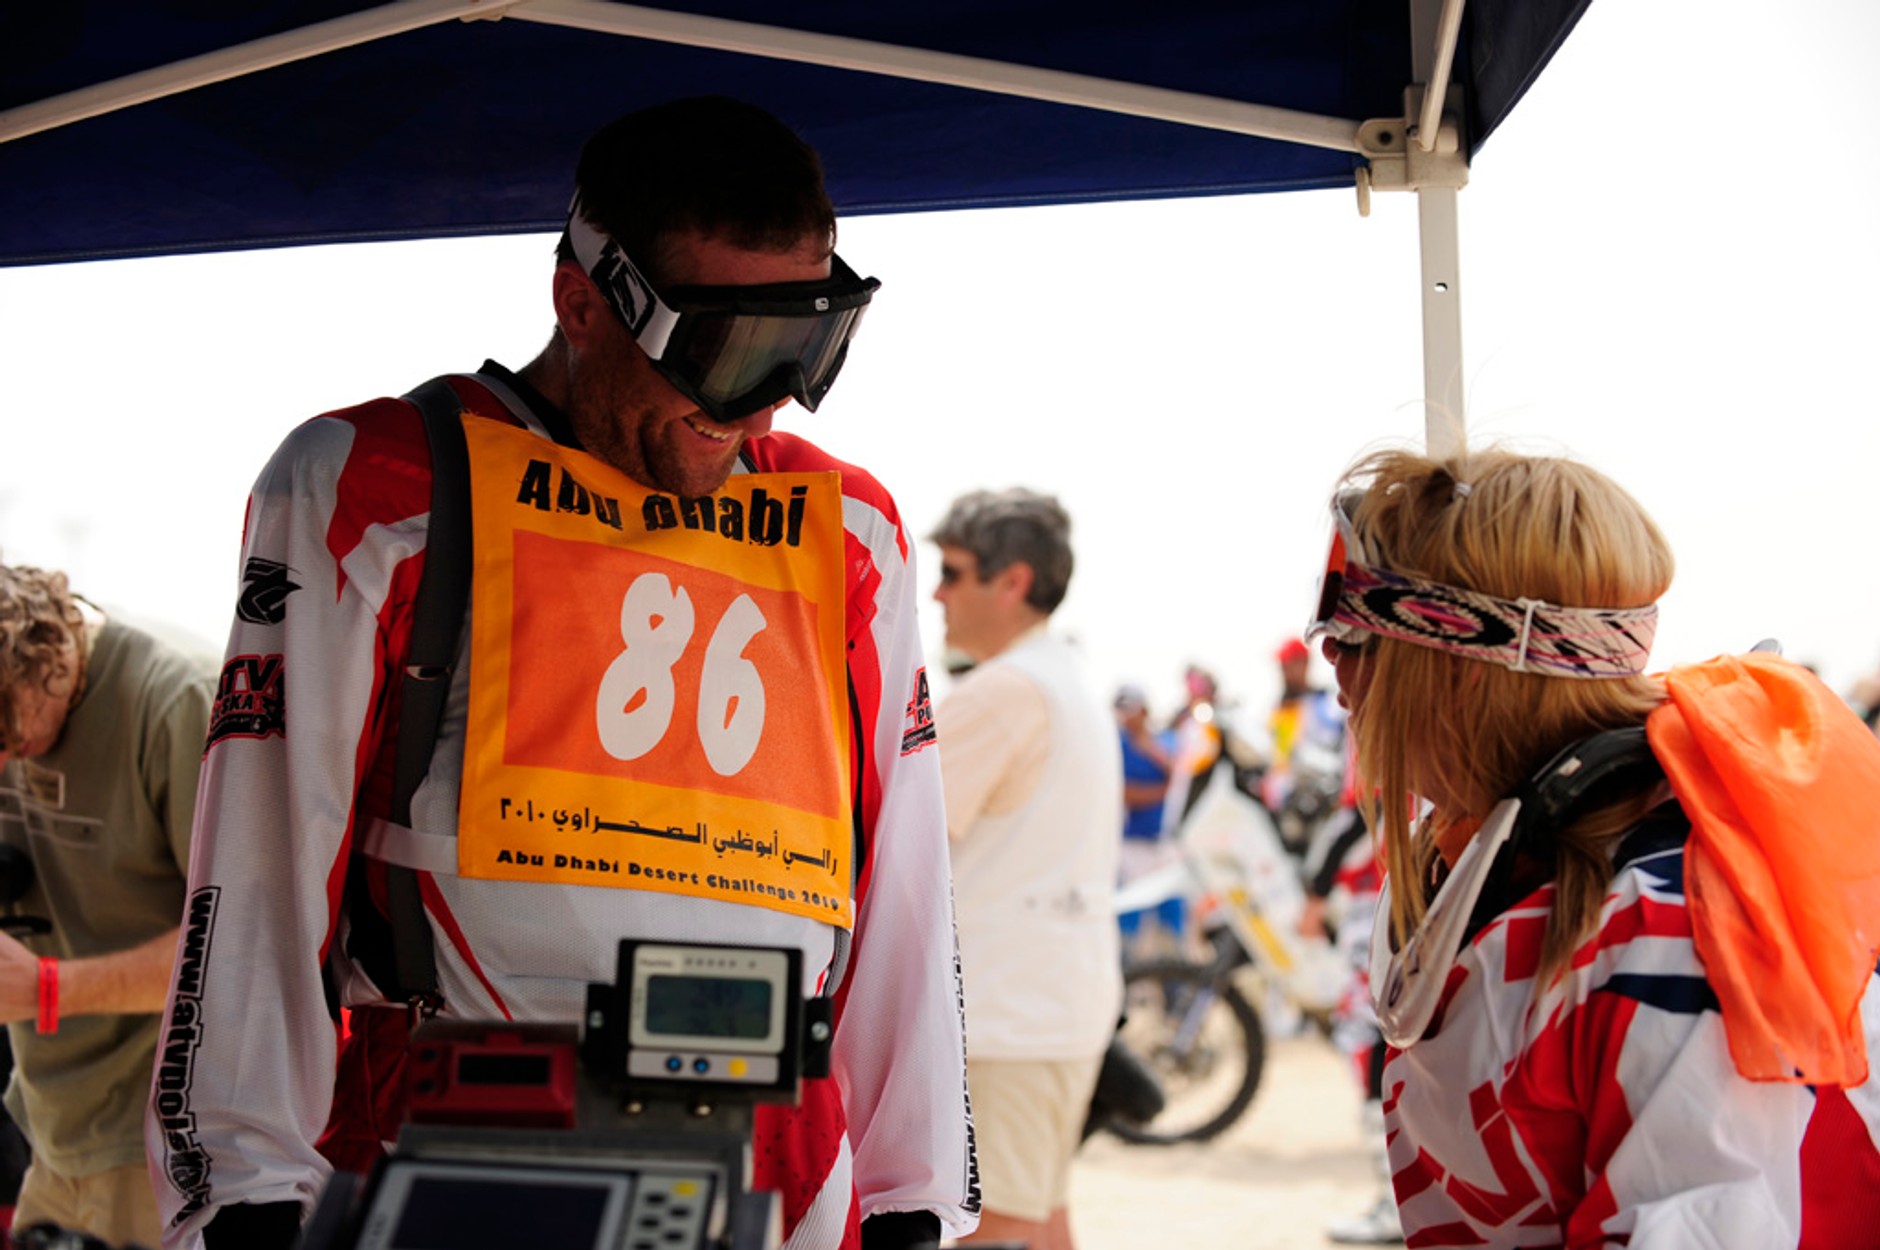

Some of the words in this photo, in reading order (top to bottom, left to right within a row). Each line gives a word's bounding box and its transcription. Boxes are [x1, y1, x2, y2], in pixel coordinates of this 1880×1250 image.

[517, 459, 623, 531] Abu
[597, 573, 768, 777] 86
[712, 829, 778, 859] أبوظبي
[496, 850, 544, 866] Abu
[554, 854, 619, 874] Dhabi
[628, 863, 699, 885] Desert
[706, 874, 796, 901] Challenge
[801, 890, 839, 911] 2010
